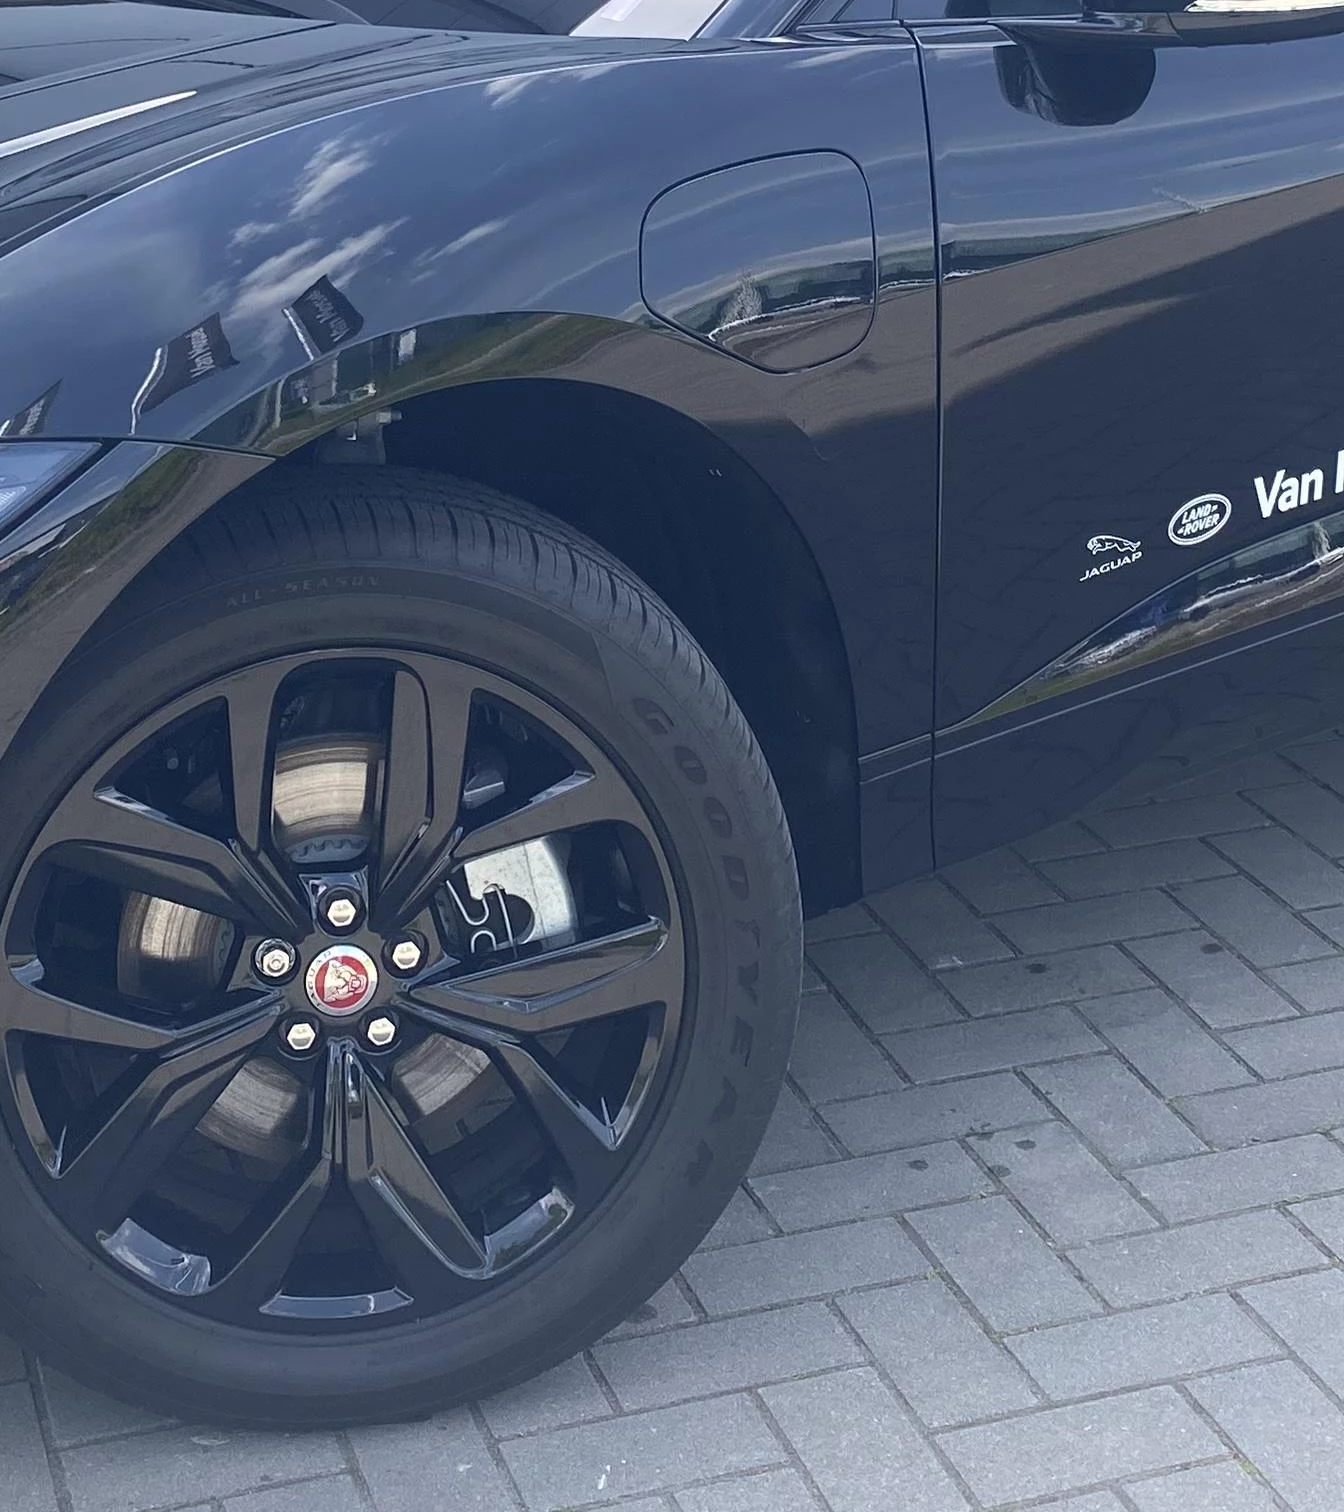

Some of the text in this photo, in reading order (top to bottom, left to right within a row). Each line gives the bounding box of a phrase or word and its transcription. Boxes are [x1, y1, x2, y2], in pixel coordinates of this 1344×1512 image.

[1253, 469, 1323, 518] Van
[1182, 504, 1212, 523] LAND
[1184, 515, 1220, 536] ROVER
